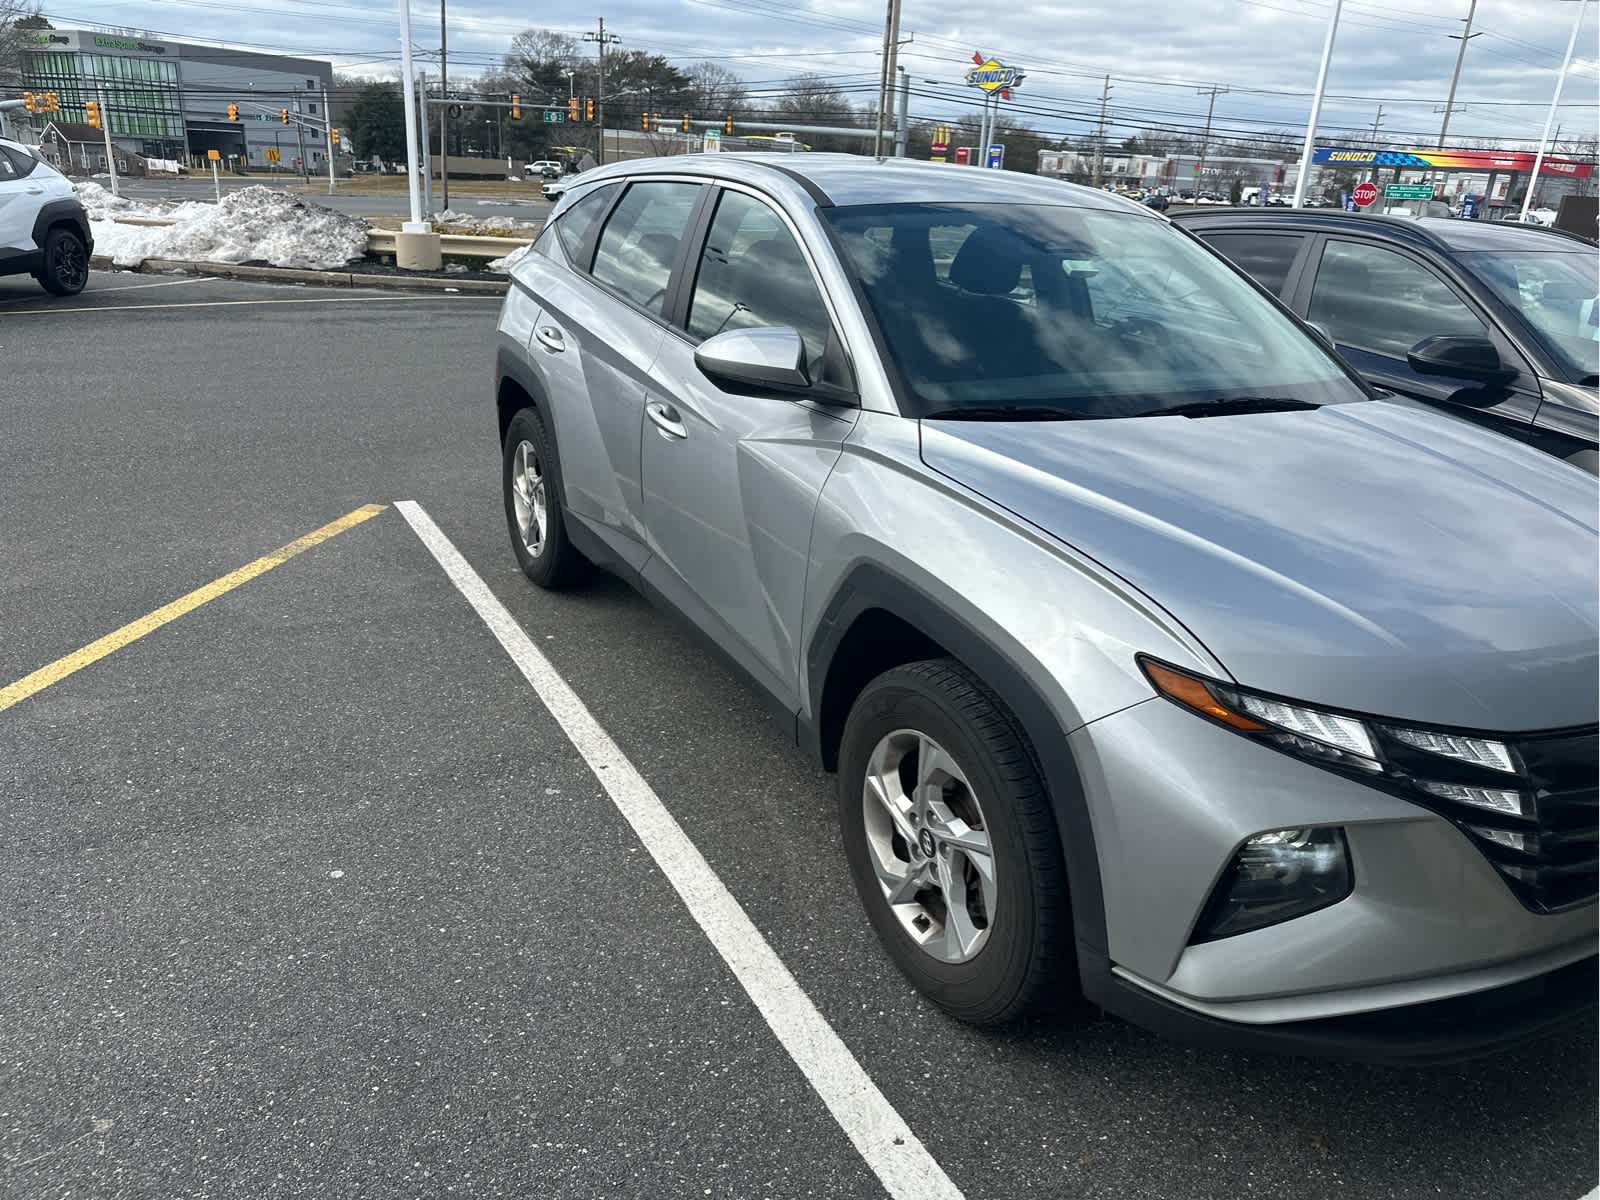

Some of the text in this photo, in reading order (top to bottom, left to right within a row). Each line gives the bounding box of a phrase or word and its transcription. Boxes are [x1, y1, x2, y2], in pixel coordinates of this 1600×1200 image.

[969, 71, 1012, 83] SUNOCO
[1328, 152, 1376, 161] SUNOCO
[1354, 190, 1375, 199] STOP
